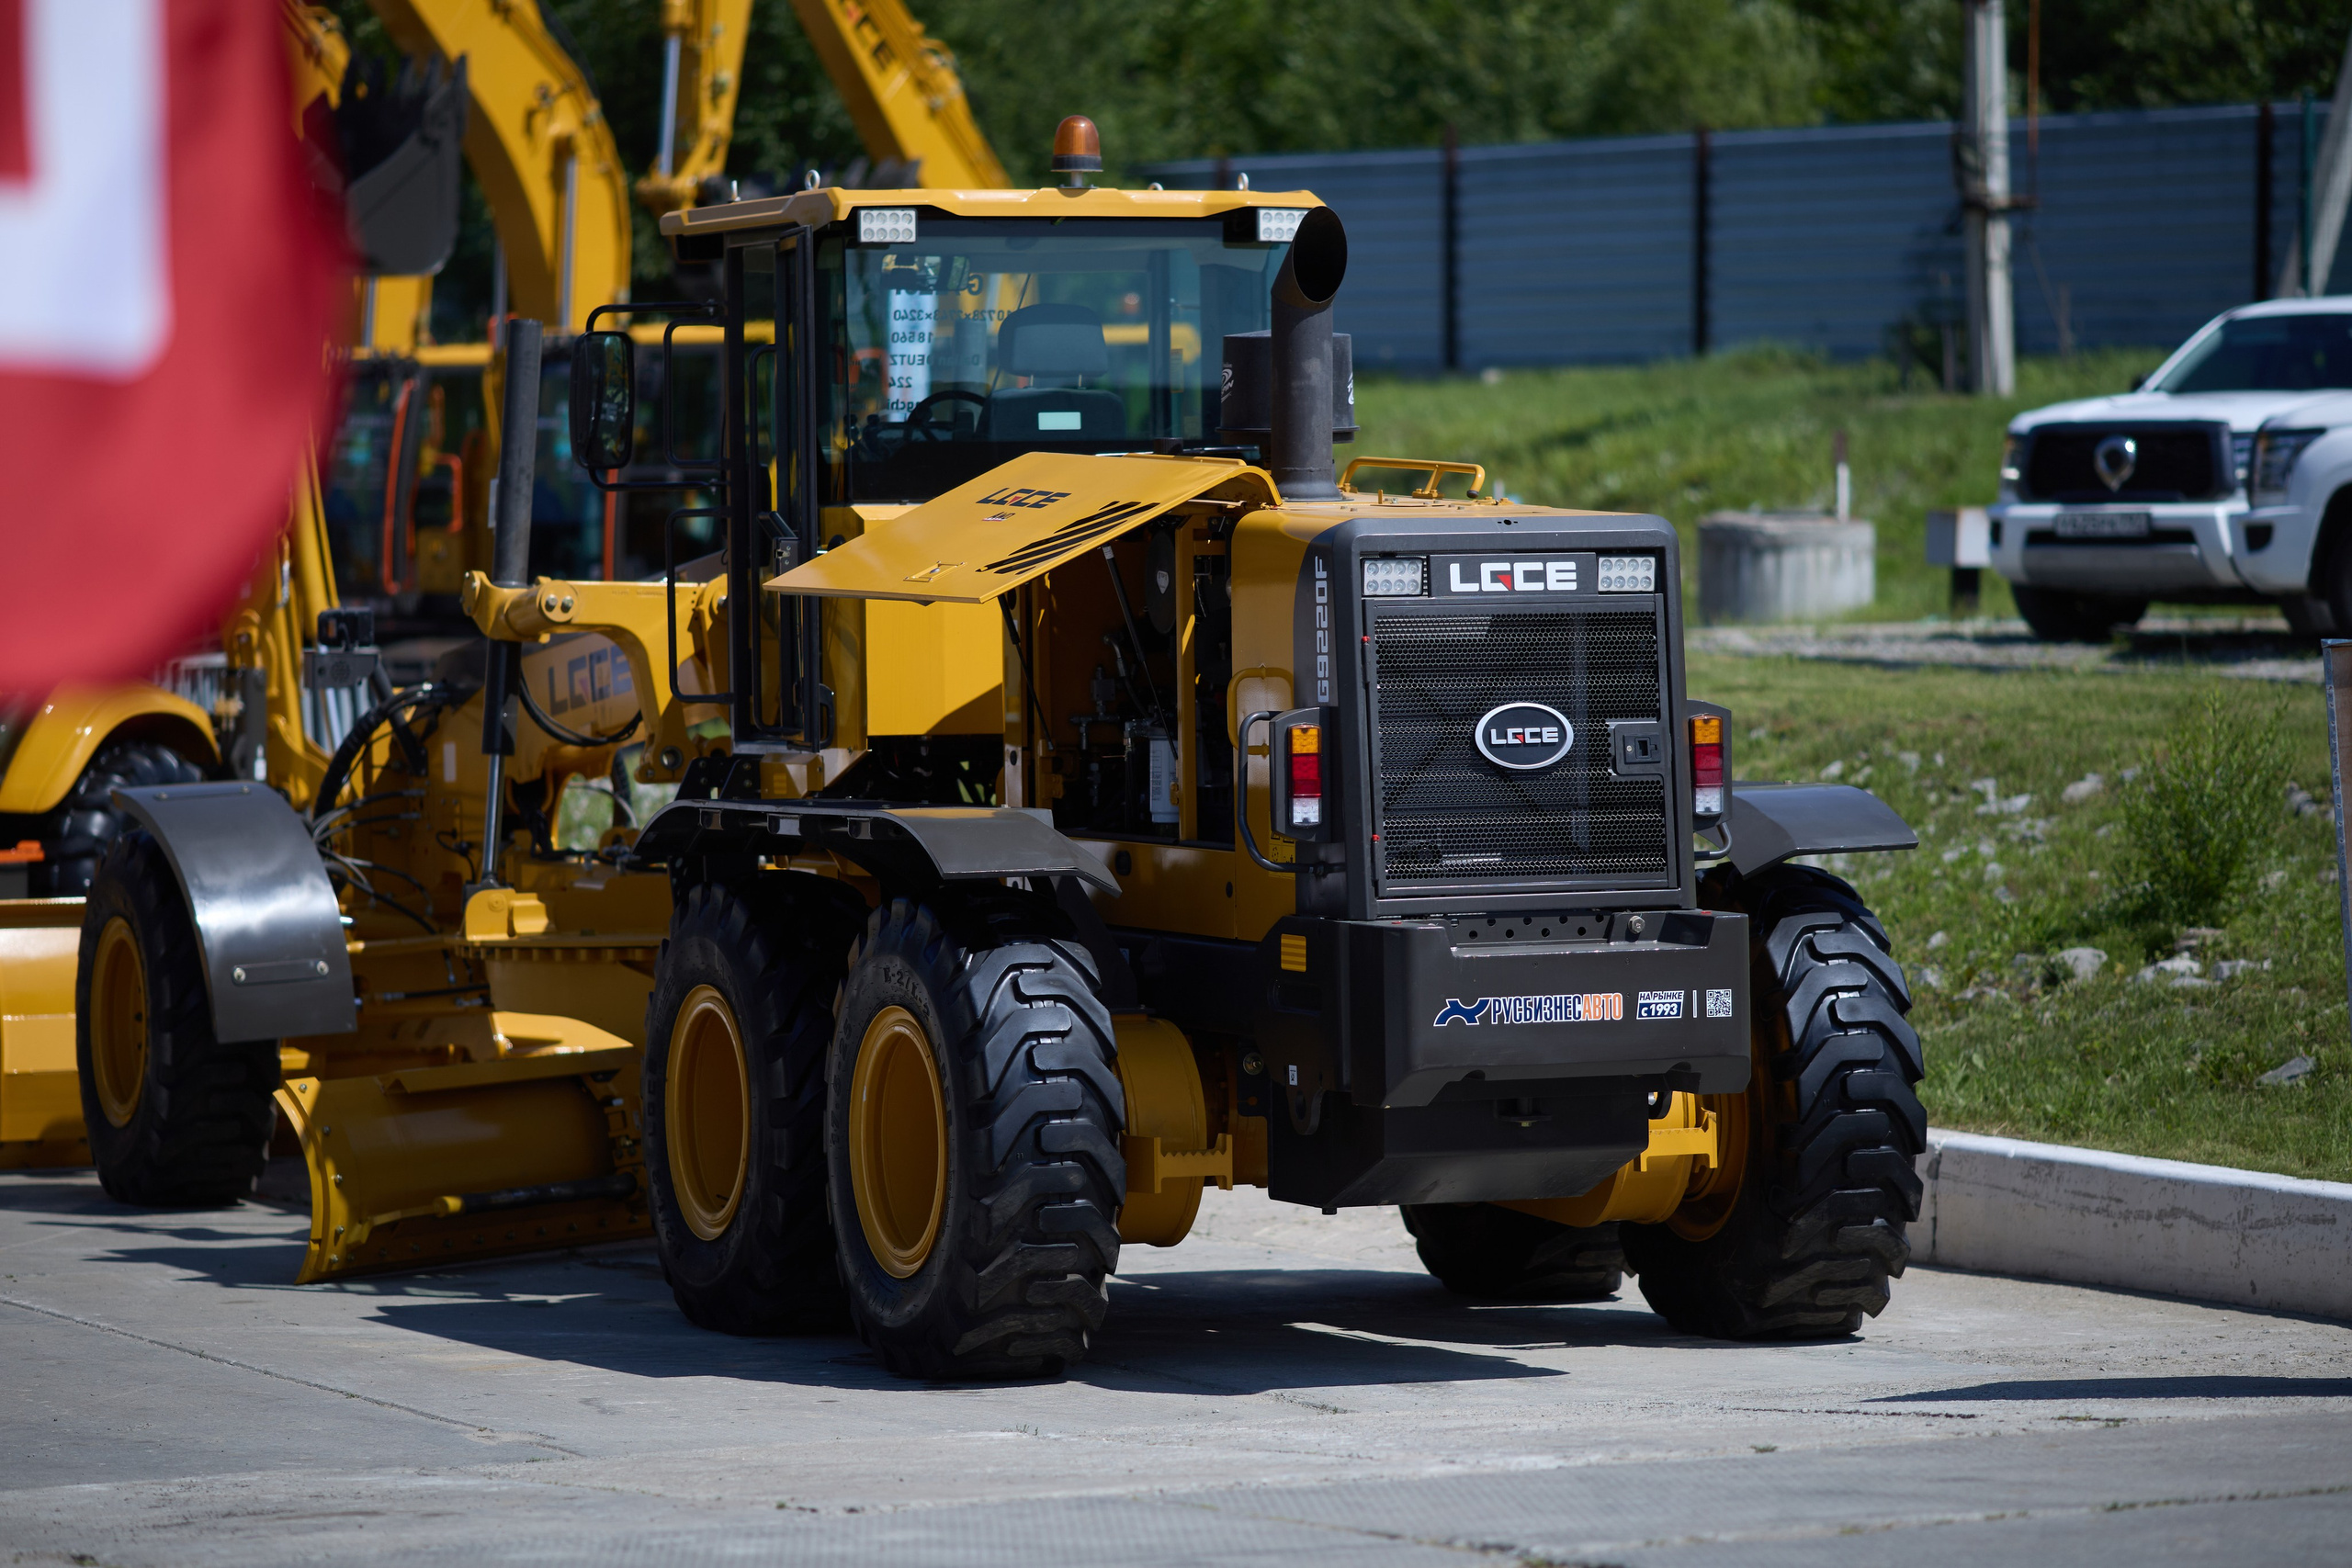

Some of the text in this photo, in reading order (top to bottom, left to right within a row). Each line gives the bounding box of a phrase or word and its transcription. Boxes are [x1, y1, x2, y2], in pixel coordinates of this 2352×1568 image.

[976, 487, 1072, 509] LGCE
[1449, 560, 1578, 592] LGCE
[1314, 555, 1329, 704] G9220F
[548, 644, 633, 716] LGCE
[1490, 726, 1560, 746] LGCE
[1491, 993, 1623, 1025] РУСБИЗНЕСАВТО
[1639, 991, 1683, 1001] НА РЫНКЕ
[1649, 1003, 1679, 1016] 1993
